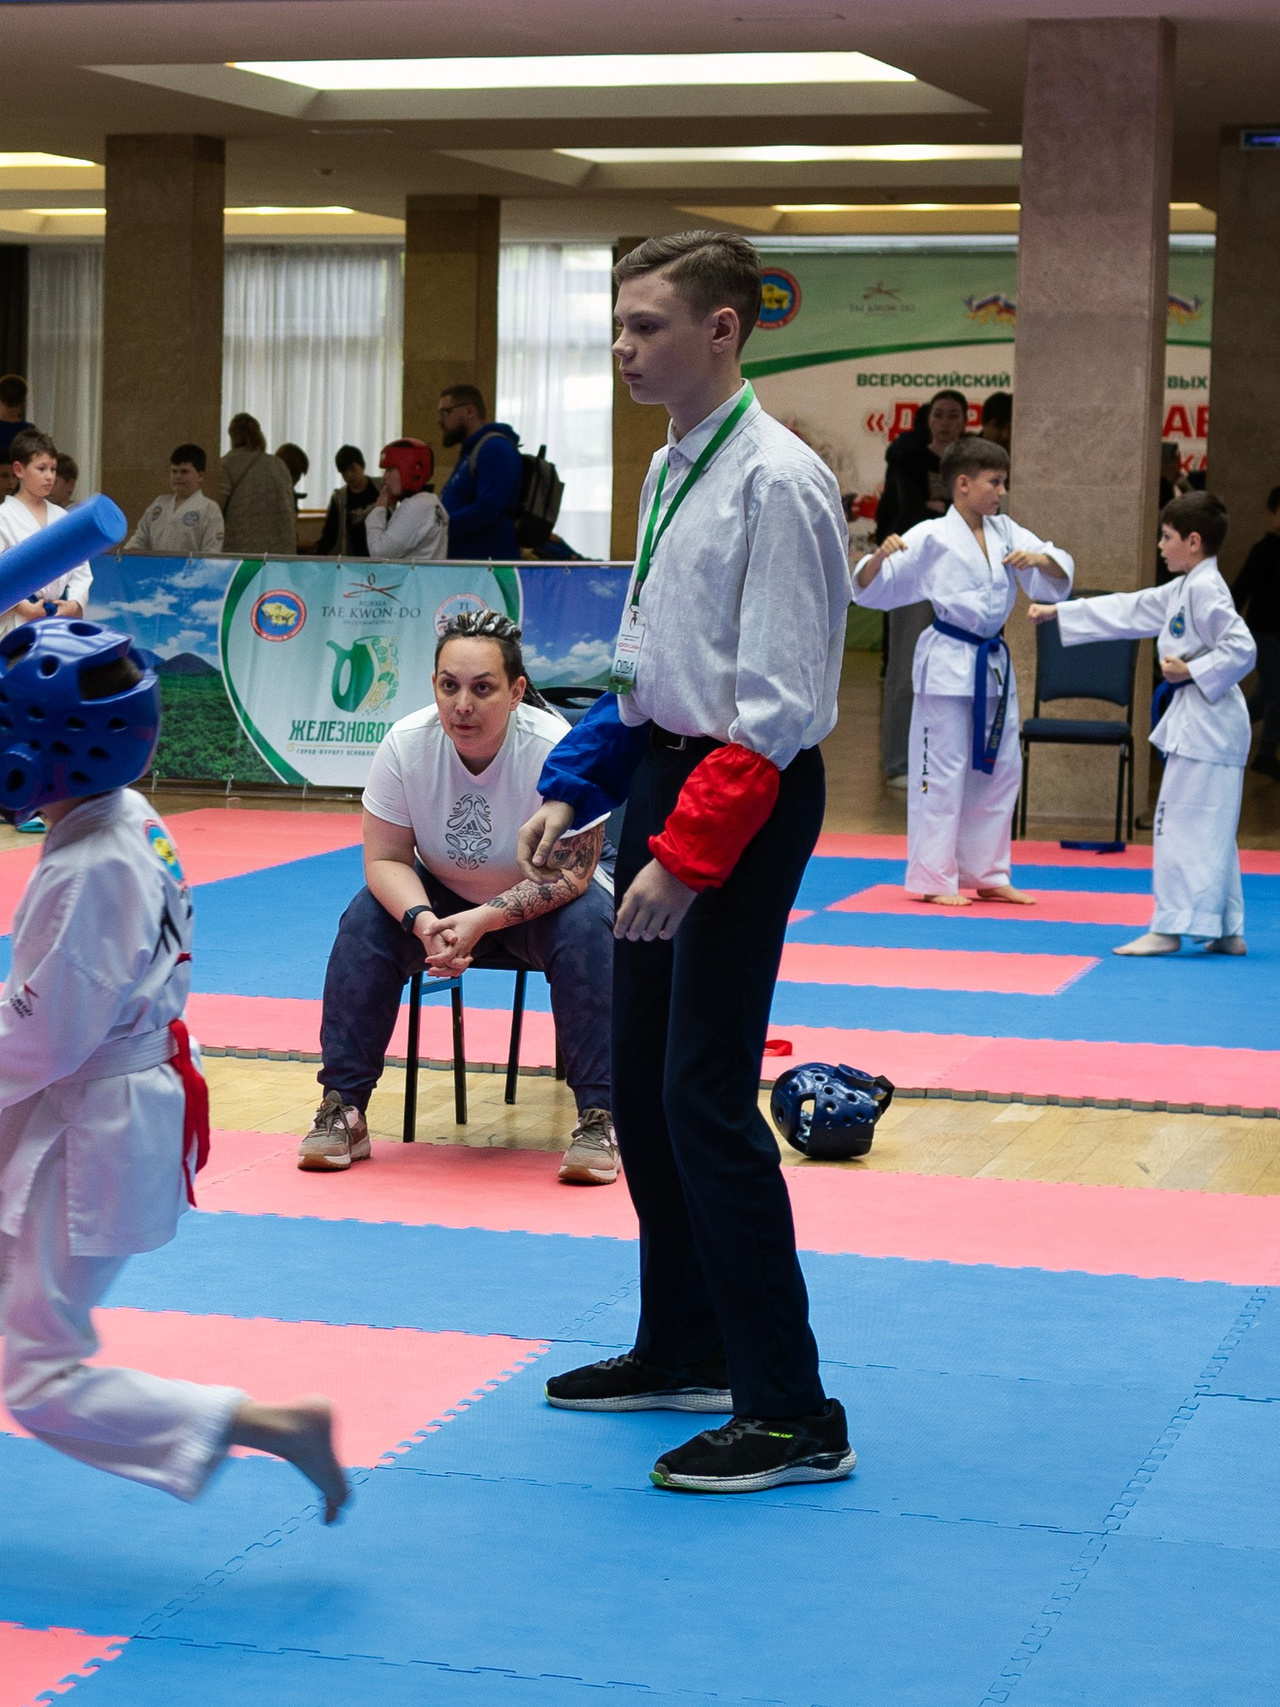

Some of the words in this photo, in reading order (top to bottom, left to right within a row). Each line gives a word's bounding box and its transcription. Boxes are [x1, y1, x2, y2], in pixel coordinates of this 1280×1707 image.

[856, 371, 1011, 388] ВСЕРОССИЙСКИЙ
[322, 606, 345, 618] TAE
[349, 606, 422, 619] KWON-DO
